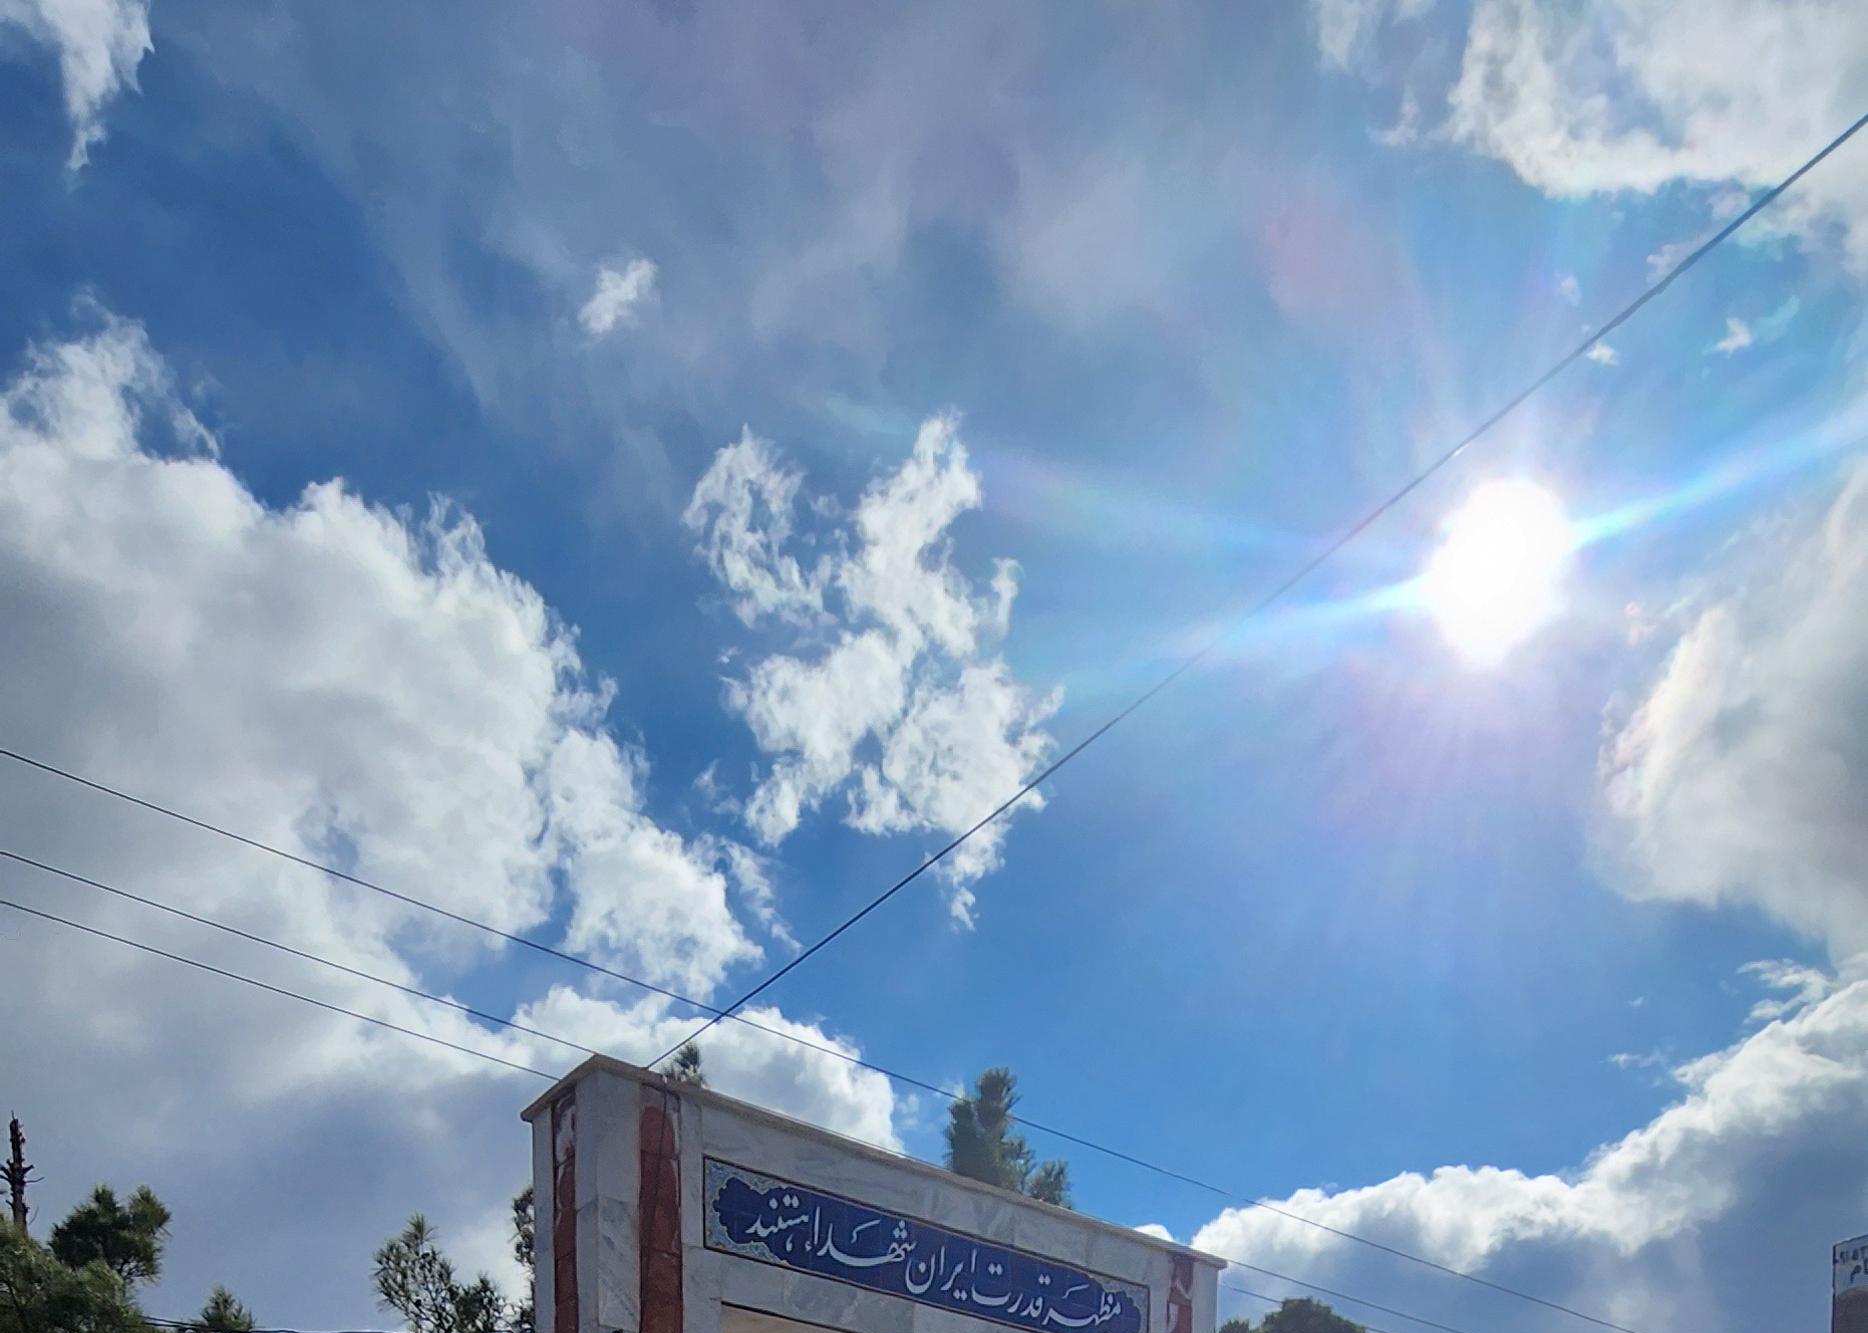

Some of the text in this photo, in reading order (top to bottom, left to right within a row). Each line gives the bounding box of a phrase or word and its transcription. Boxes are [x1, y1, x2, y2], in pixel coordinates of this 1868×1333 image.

[745, 1194, 810, 1252] هستند
[905, 1246, 977, 1301] ایران
[971, 1263, 1051, 1318] قدرت
[1042, 1284, 1122, 1327] مظهر
